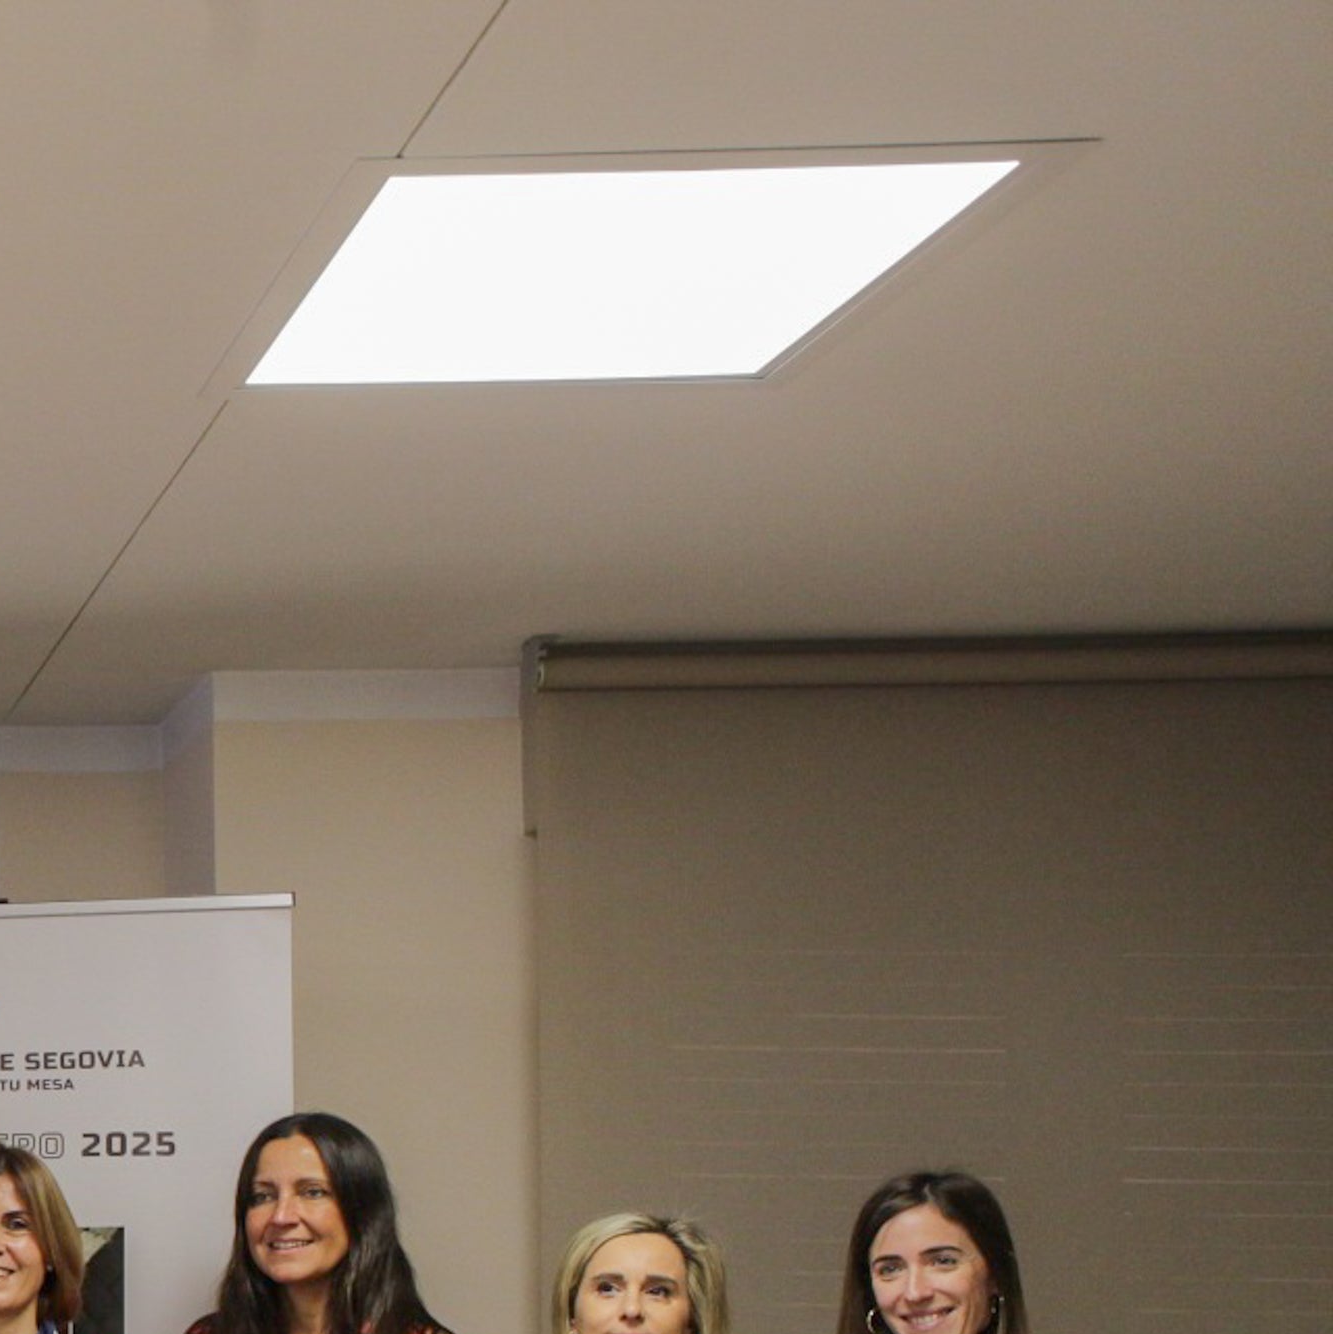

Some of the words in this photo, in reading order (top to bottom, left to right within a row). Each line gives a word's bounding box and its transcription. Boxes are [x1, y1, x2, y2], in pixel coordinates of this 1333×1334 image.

[24, 1050, 145, 1071] SEGOVIA
[0, 1079, 21, 1092] TU
[27, 1078, 75, 1091] MESA
[81, 1131, 177, 1157] 2025
